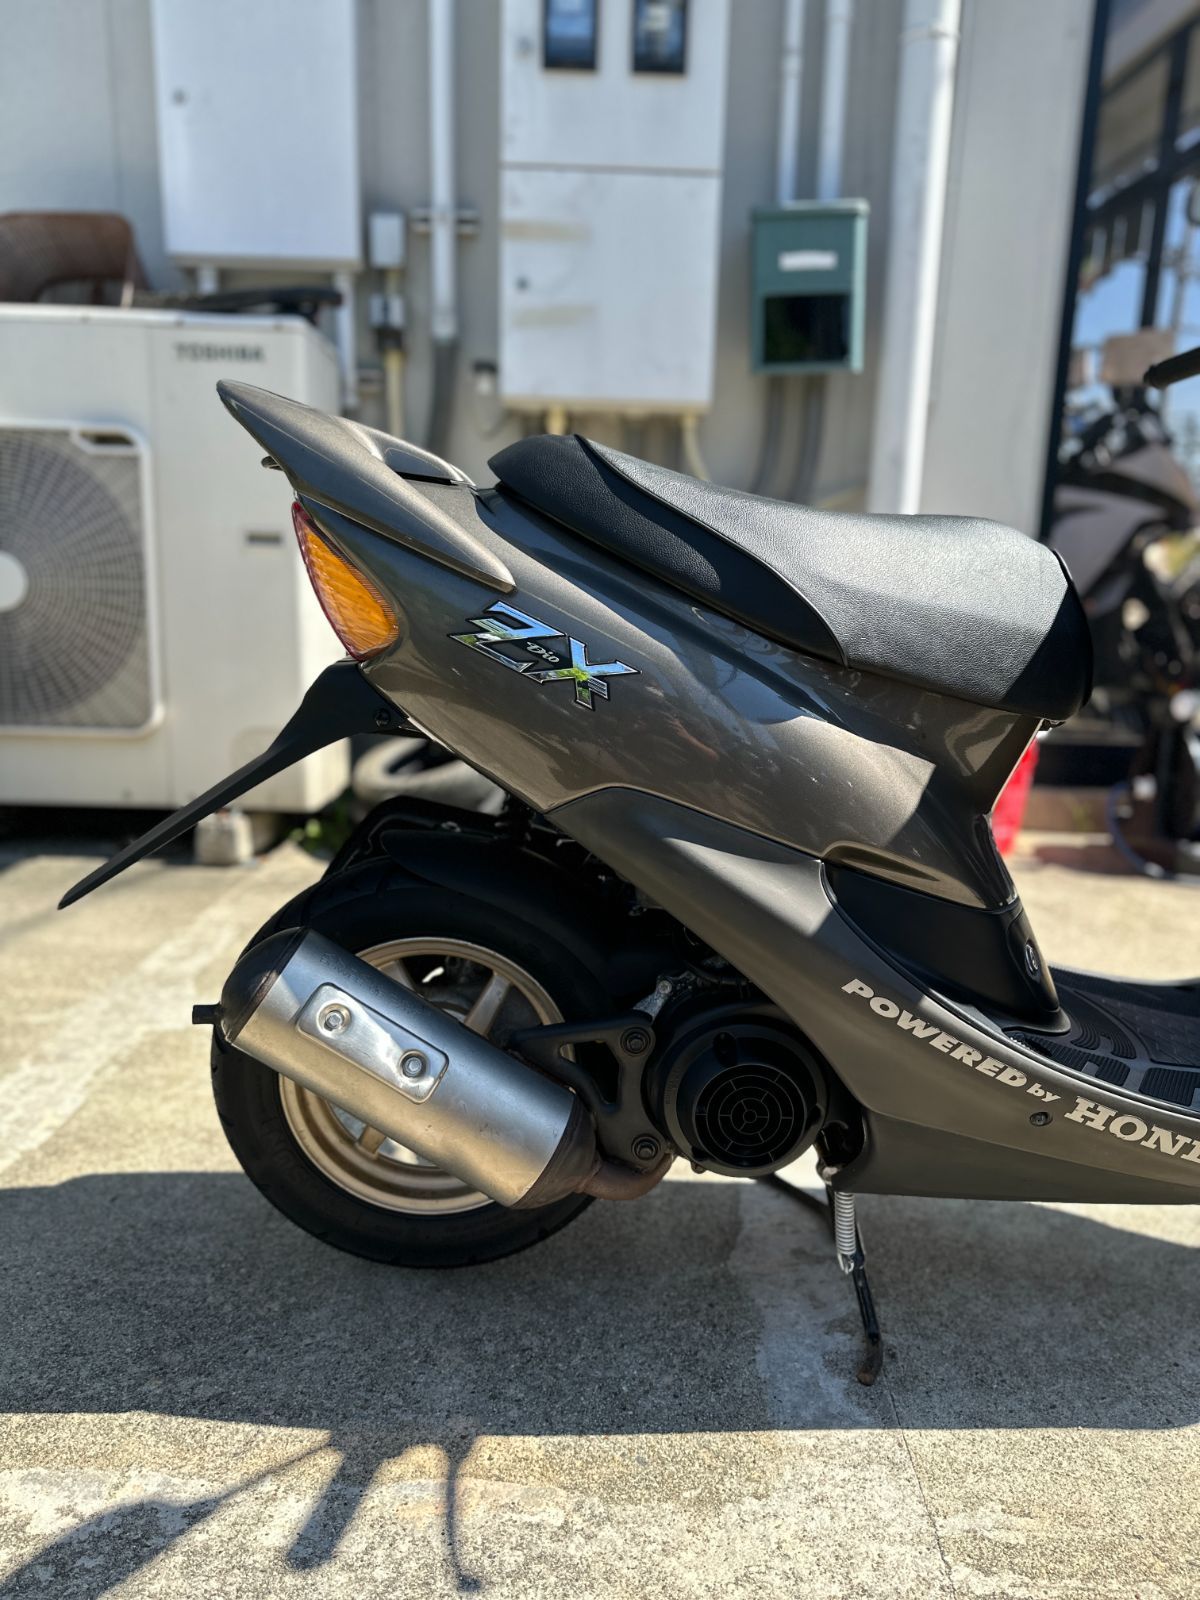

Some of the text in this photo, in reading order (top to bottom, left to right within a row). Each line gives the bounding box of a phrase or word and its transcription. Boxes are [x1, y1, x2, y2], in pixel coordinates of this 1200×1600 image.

[174, 342, 265, 361] TOSHIBA
[447, 600, 641, 711] ZX
[526, 641, 560, 663] Dio
[841, 978, 1027, 1088] POWERED
[1026, 1083, 1061, 1103] by
